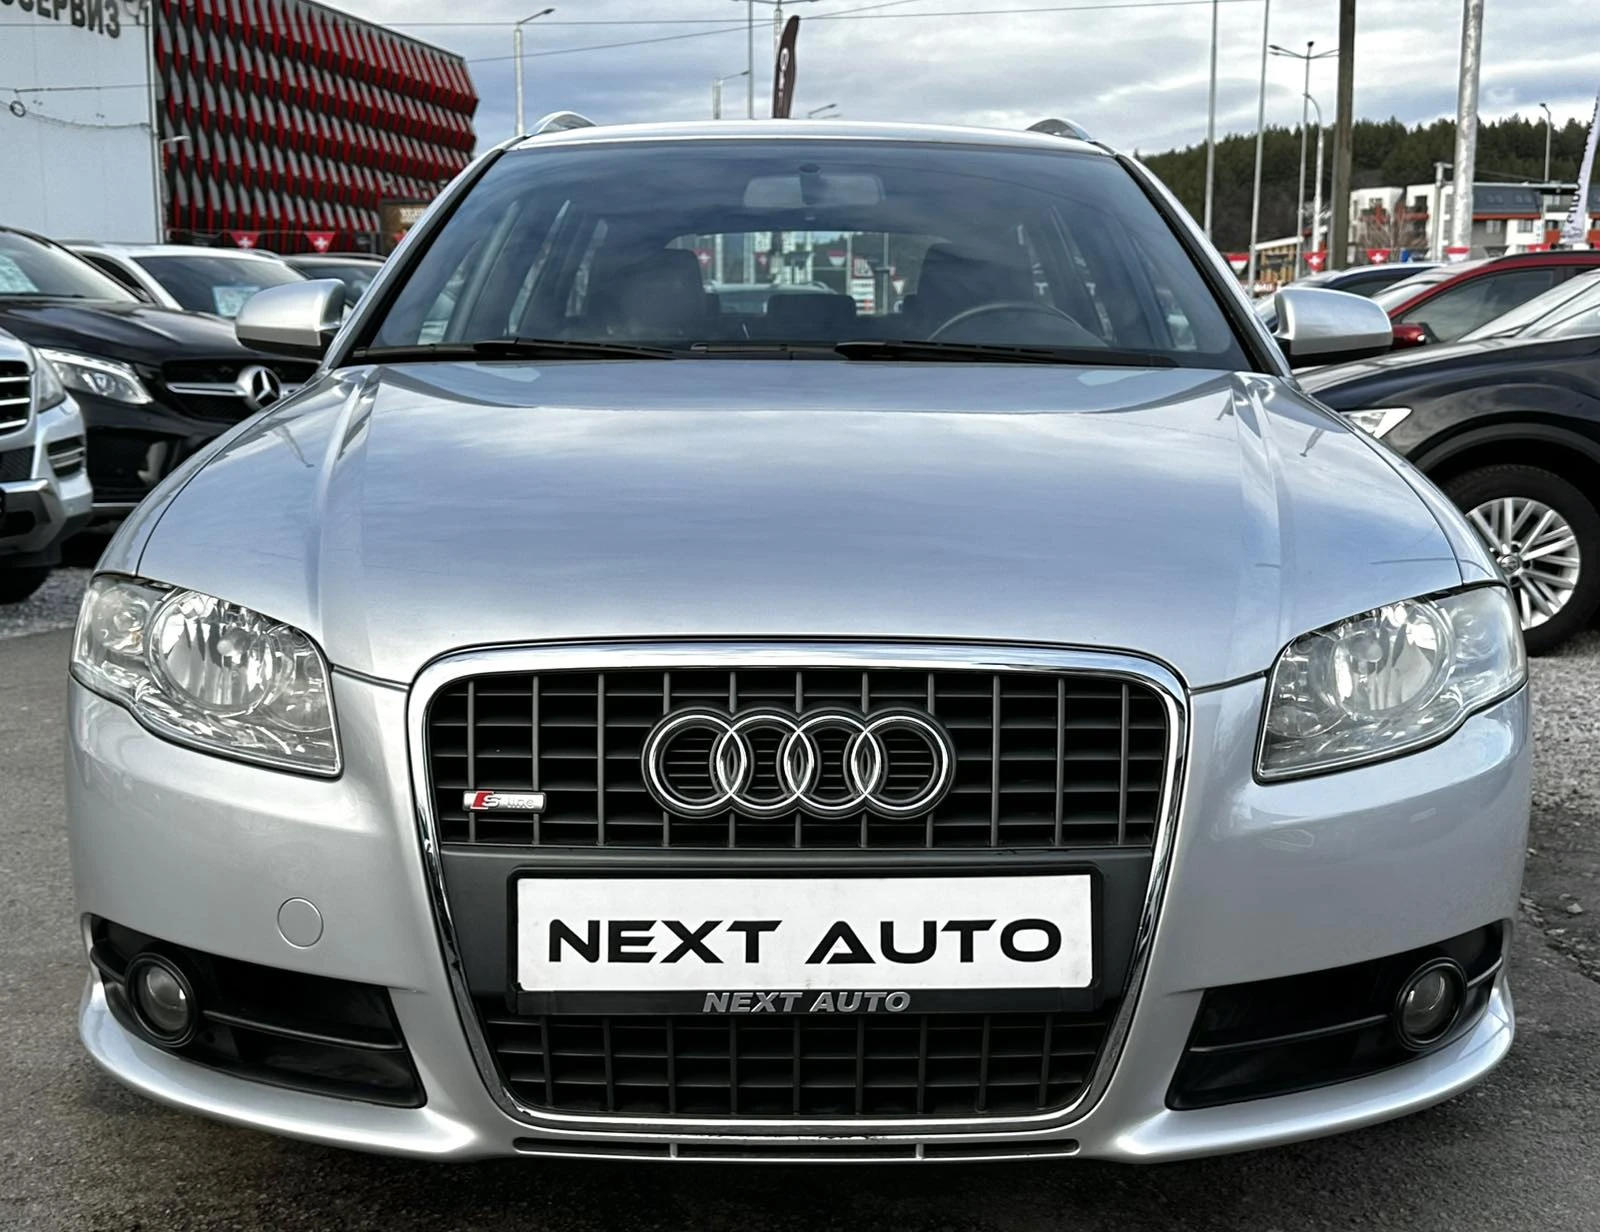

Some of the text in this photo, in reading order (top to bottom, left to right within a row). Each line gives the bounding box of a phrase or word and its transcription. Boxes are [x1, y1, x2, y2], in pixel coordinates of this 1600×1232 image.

[0, 0, 120, 38] ЕРВИЗ
[548, 919, 1062, 964] NEXT AUTO
[703, 992, 911, 1013] NEXT AUTO
